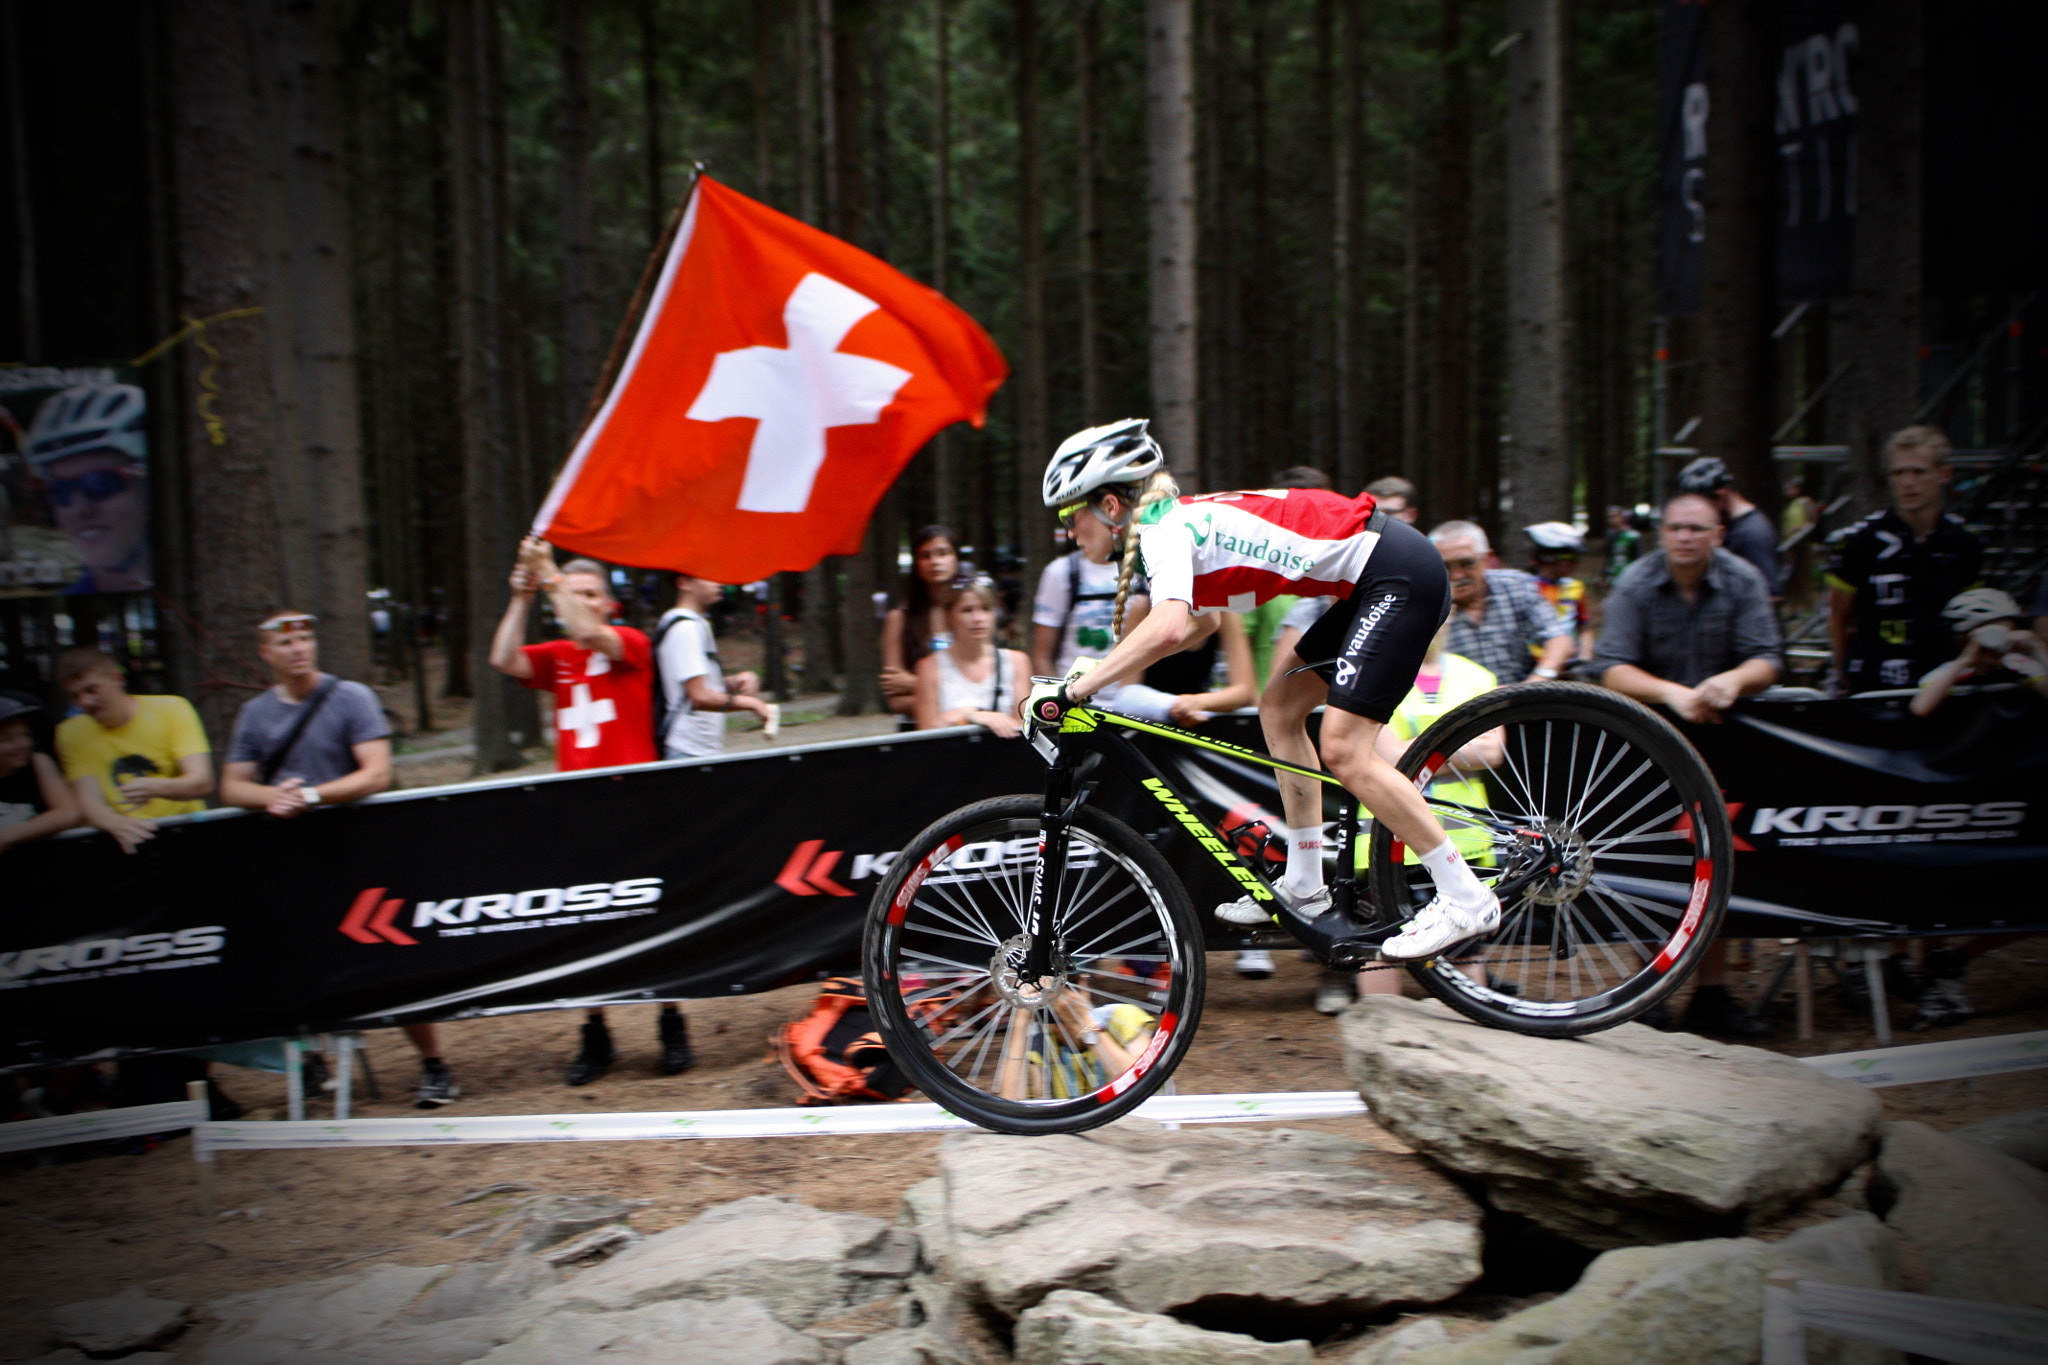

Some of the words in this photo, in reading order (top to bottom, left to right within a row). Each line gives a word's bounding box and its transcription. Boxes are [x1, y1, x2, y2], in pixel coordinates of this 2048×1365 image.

[1215, 529, 1315, 573] vaudoise
[1345, 594, 1397, 657] vaudoise
[1141, 777, 1274, 902] WHEELER
[1750, 801, 2029, 834] KROSS
[850, 836, 1100, 880] KOSS
[411, 877, 664, 928] KROSS
